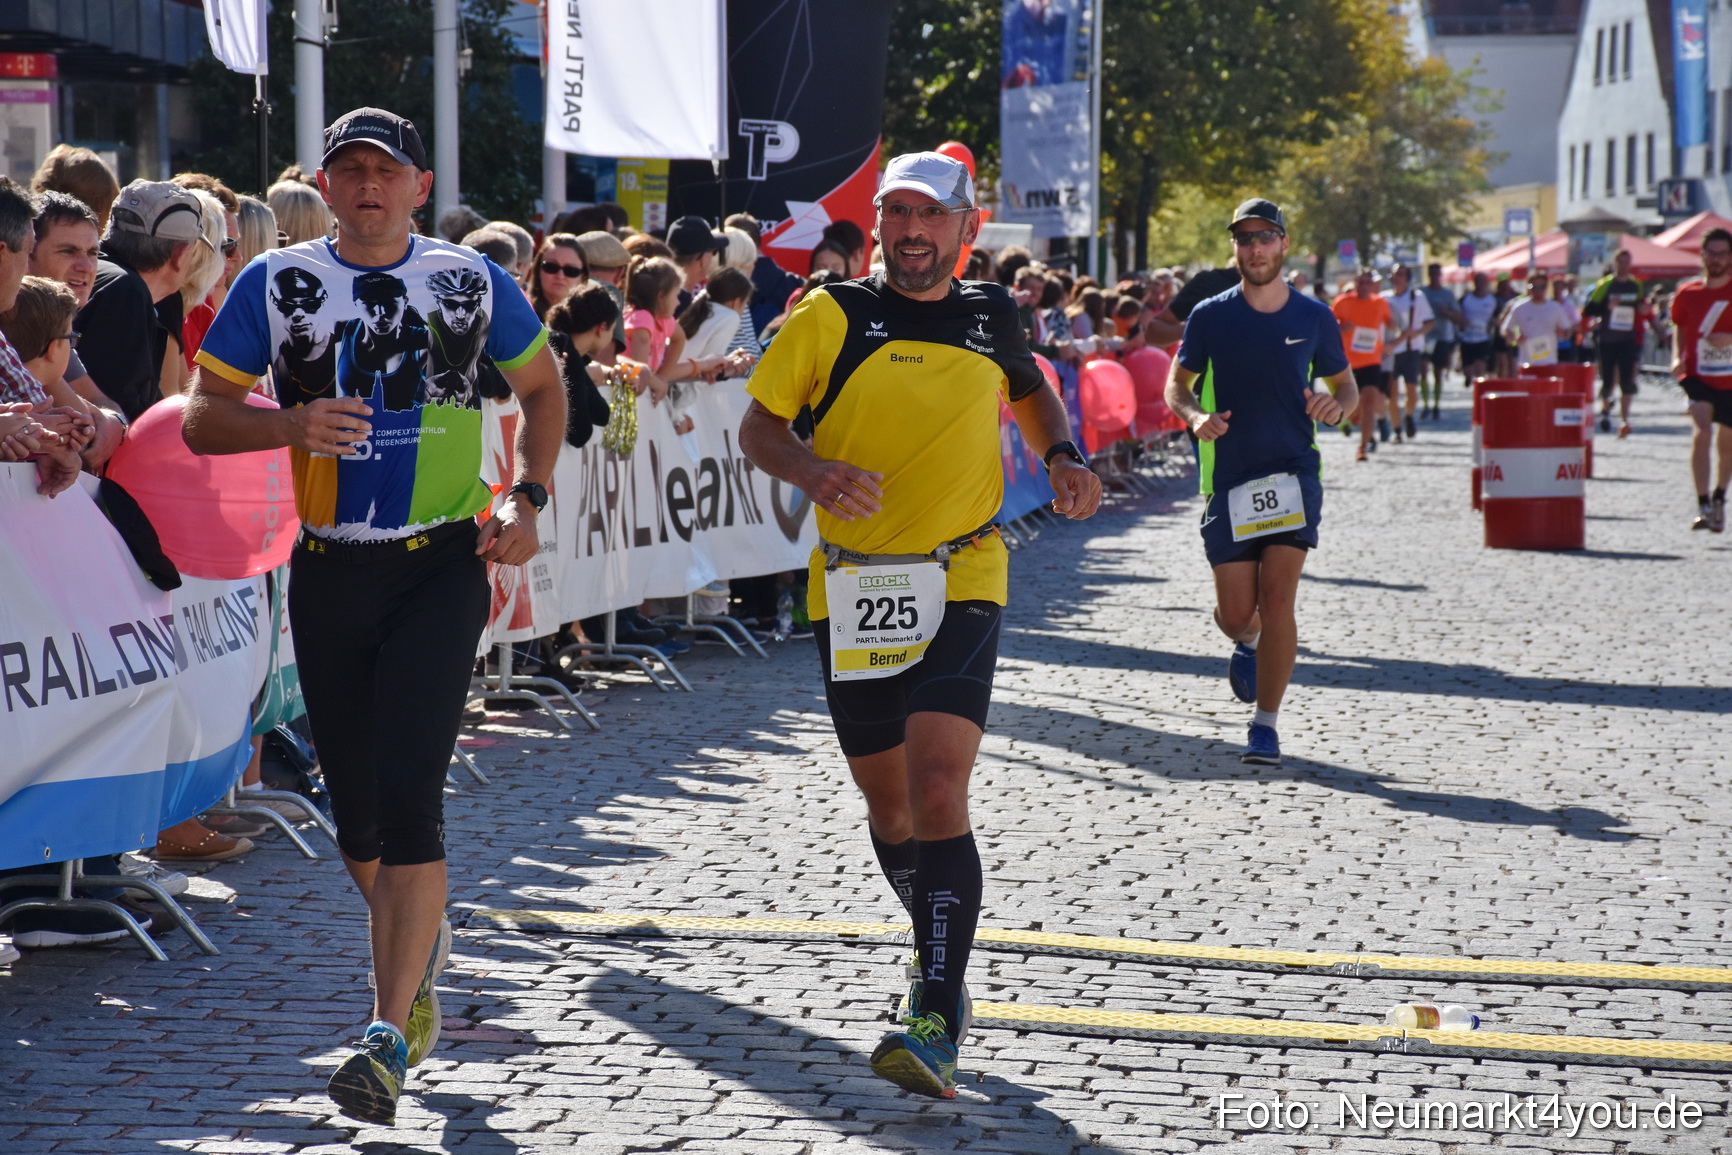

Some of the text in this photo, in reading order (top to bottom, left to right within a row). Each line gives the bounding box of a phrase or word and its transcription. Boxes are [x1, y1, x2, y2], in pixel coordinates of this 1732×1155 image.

[865, 330, 889, 338] erima
[890, 353, 924, 364] Bernd
[375, 436, 422, 447] REGENSBURG
[1252, 489, 1279, 513] 58
[1256, 520, 1284, 531] Stefan
[859, 574, 911, 588] BOCK
[855, 596, 919, 632] 225
[855, 635, 914, 645] PARTL Neumarkt
[869, 650, 907, 666] Bernd
